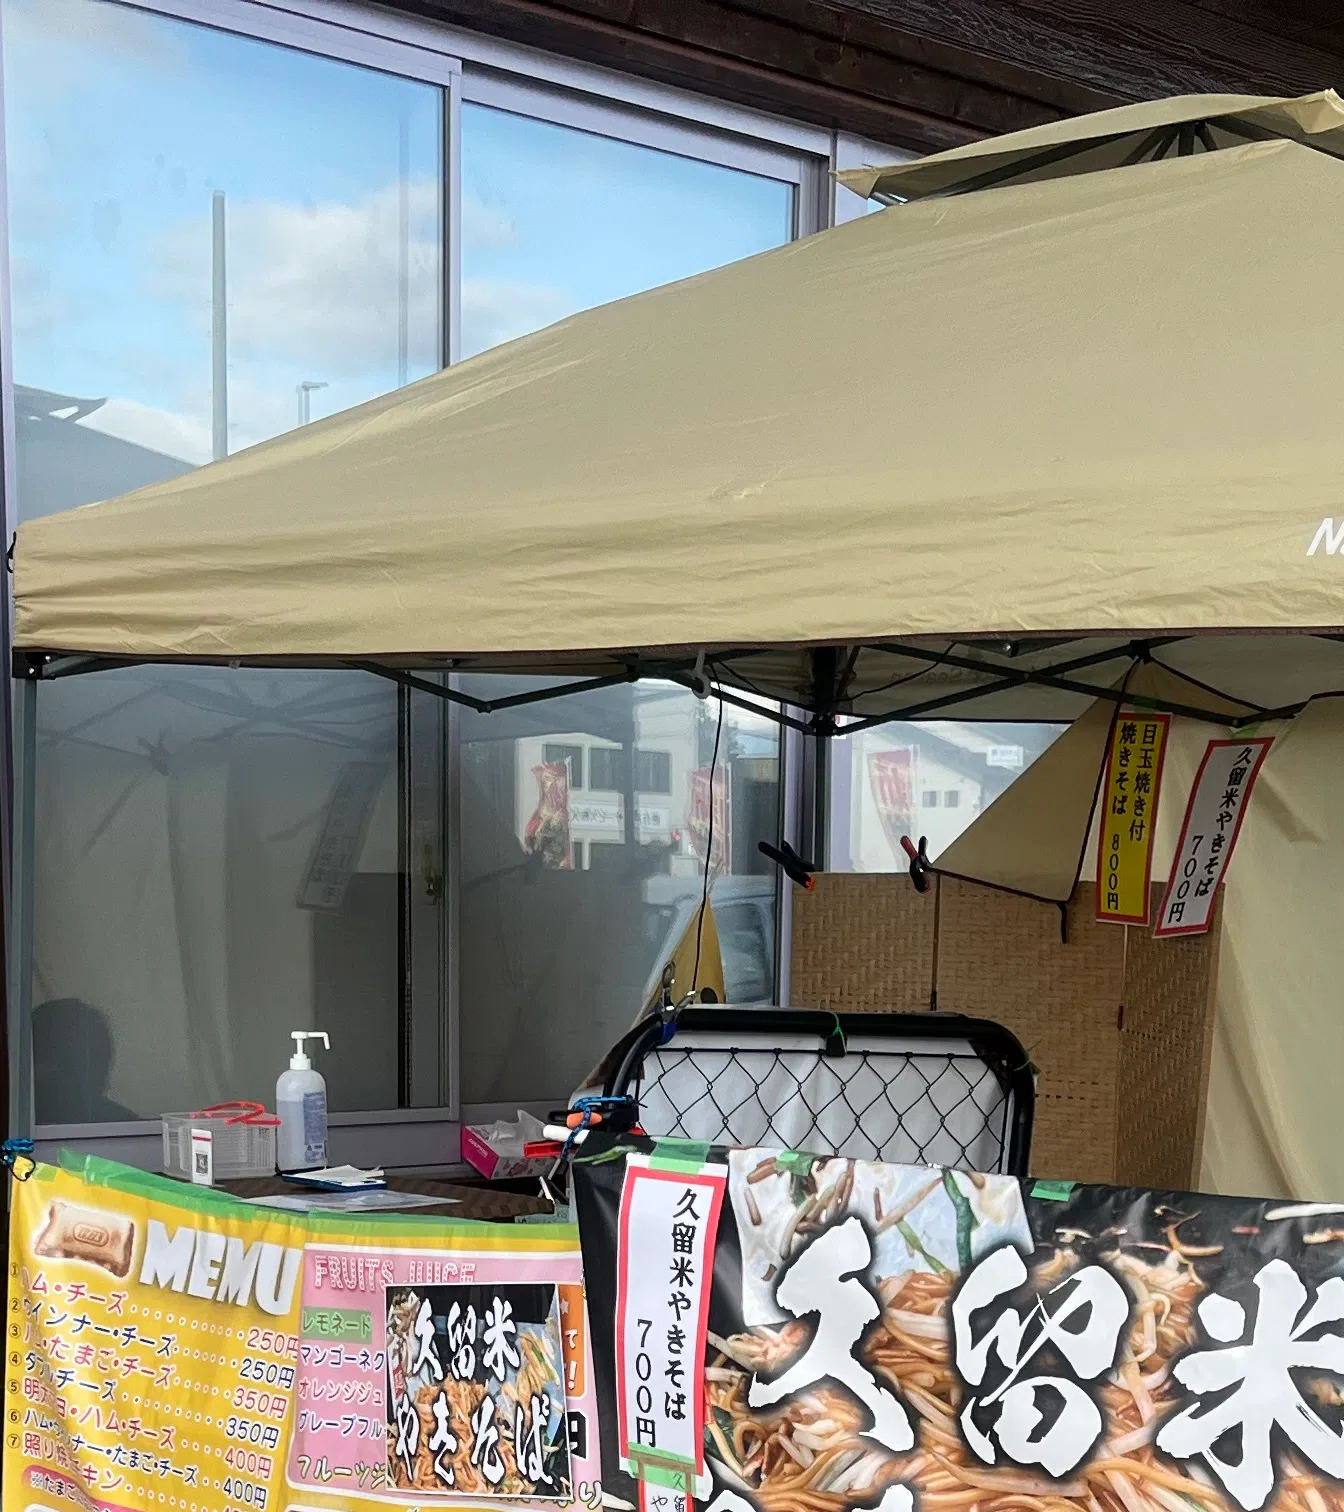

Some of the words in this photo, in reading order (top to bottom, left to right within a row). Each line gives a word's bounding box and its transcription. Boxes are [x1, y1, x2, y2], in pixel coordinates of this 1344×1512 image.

[1112, 722, 1137, 815] 焼きそば
[1129, 724, 1158, 842] 目玉焼き付
[1194, 746, 1253, 898] 久留米やきそば
[1107, 833, 1120, 911] 800円
[1167, 835, 1203, 924] 700円
[139, 1219, 303, 1315] MEMU
[314, 1255, 395, 1292] FRUITS
[402, 1261, 476, 1284] JUICE
[664, 1188, 700, 1420] 久留米やきそば
[247, 1328, 300, 1359] 250円
[302, 1309, 372, 1338] レモネード
[413, 1297, 520, 1381] 久留米
[24, 1322, 176, 1387] ・たまご・チーズ
[233, 1387, 288, 1419] 350円
[240, 1357, 295, 1390] 250円
[636, 1319, 656, 1448] 700円
[23, 1377, 175, 1450] 明ヨ・ハム・チーズ
[225, 1447, 273, 1480] 400円
[23, 1432, 123, 1490] 照り焼キン
[24, 1408, 198, 1485] ハム・ナー・たまご・チーズ
[223, 1477, 268, 1510] 400円
[225, 1417, 280, 1449] 350円
[396, 1392, 553, 1486] やきそば
